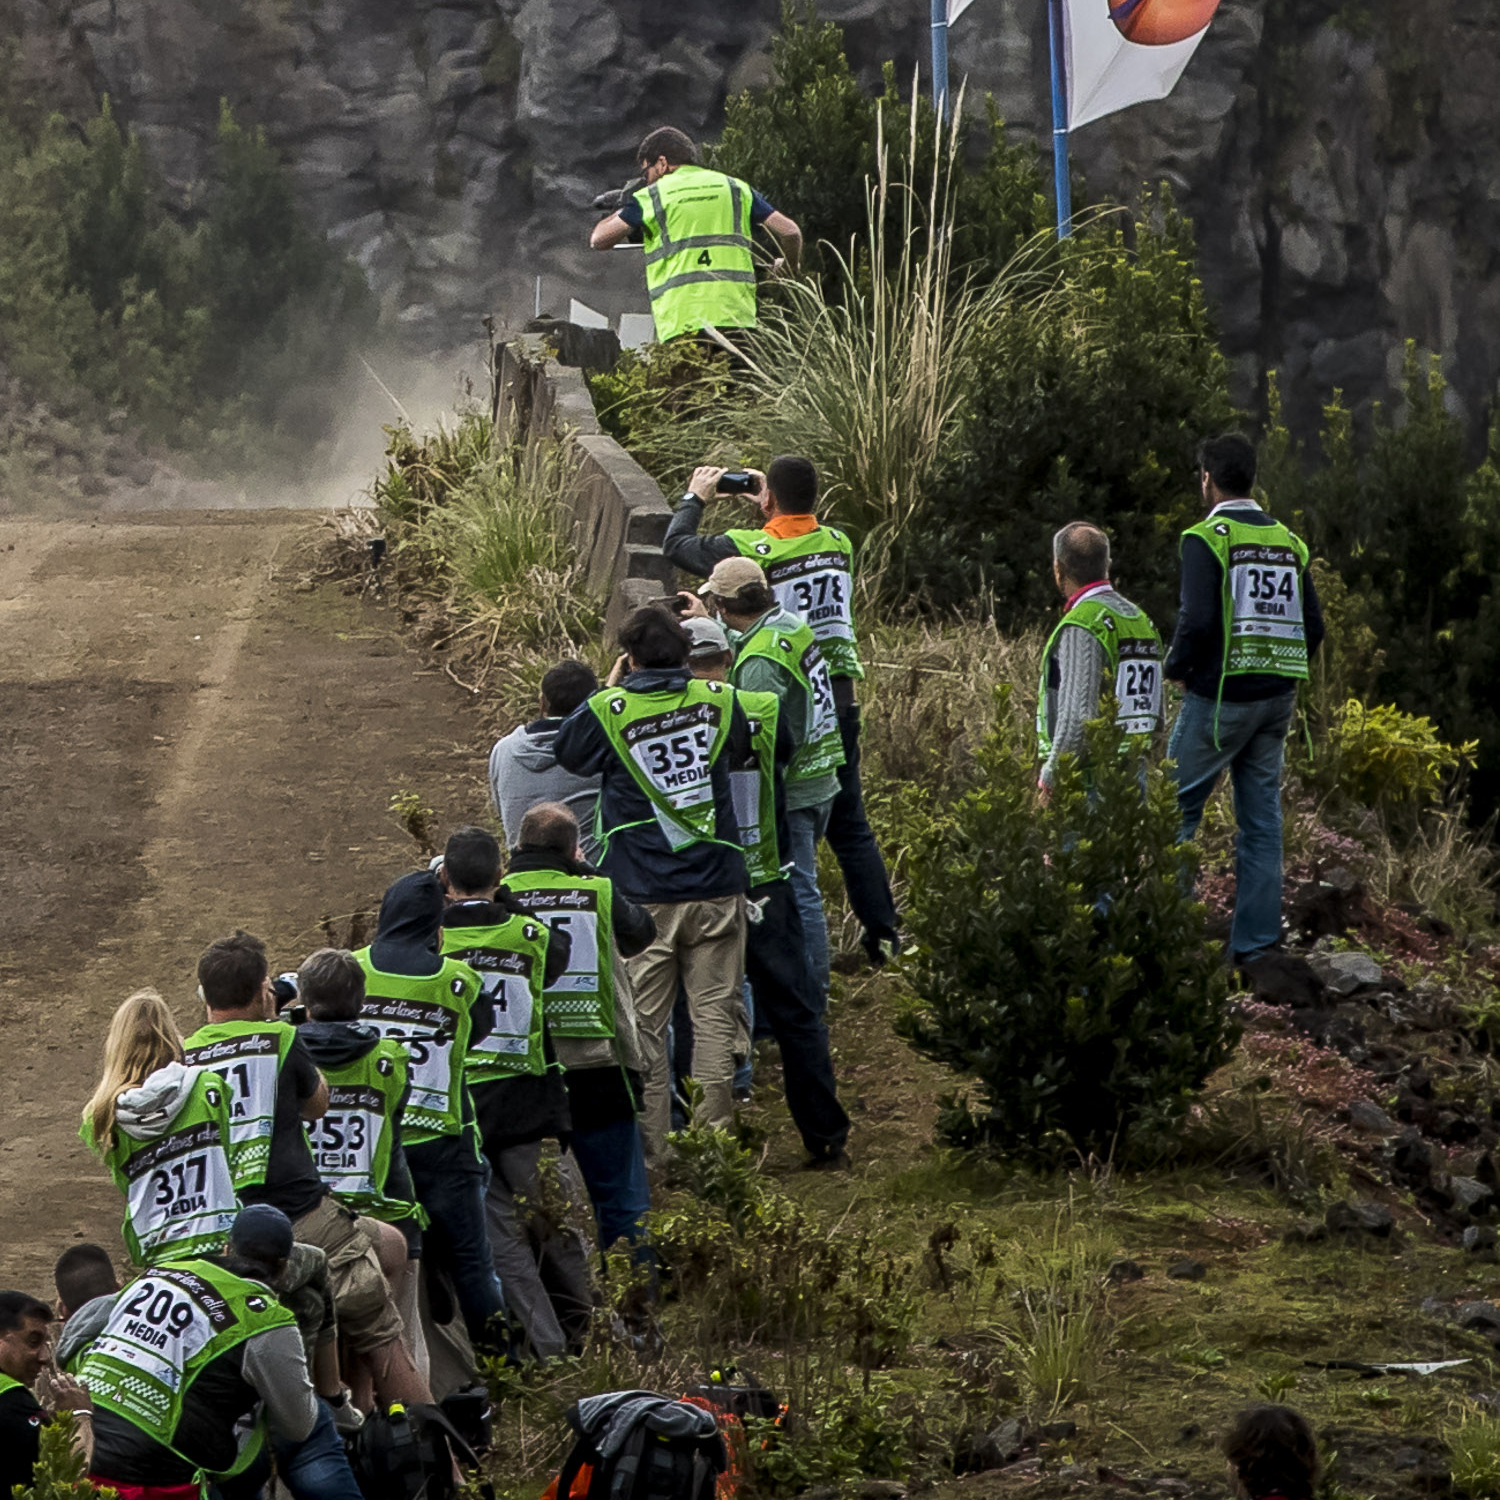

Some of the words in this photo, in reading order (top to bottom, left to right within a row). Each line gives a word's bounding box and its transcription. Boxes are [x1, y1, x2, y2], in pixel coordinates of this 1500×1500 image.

[697, 249, 712, 266] 4
[1248, 568, 1294, 602] 354
[151, 1154, 208, 1206] 317
[124, 1282, 194, 1339] 209
[123, 1319, 169, 1350] MEDIA
